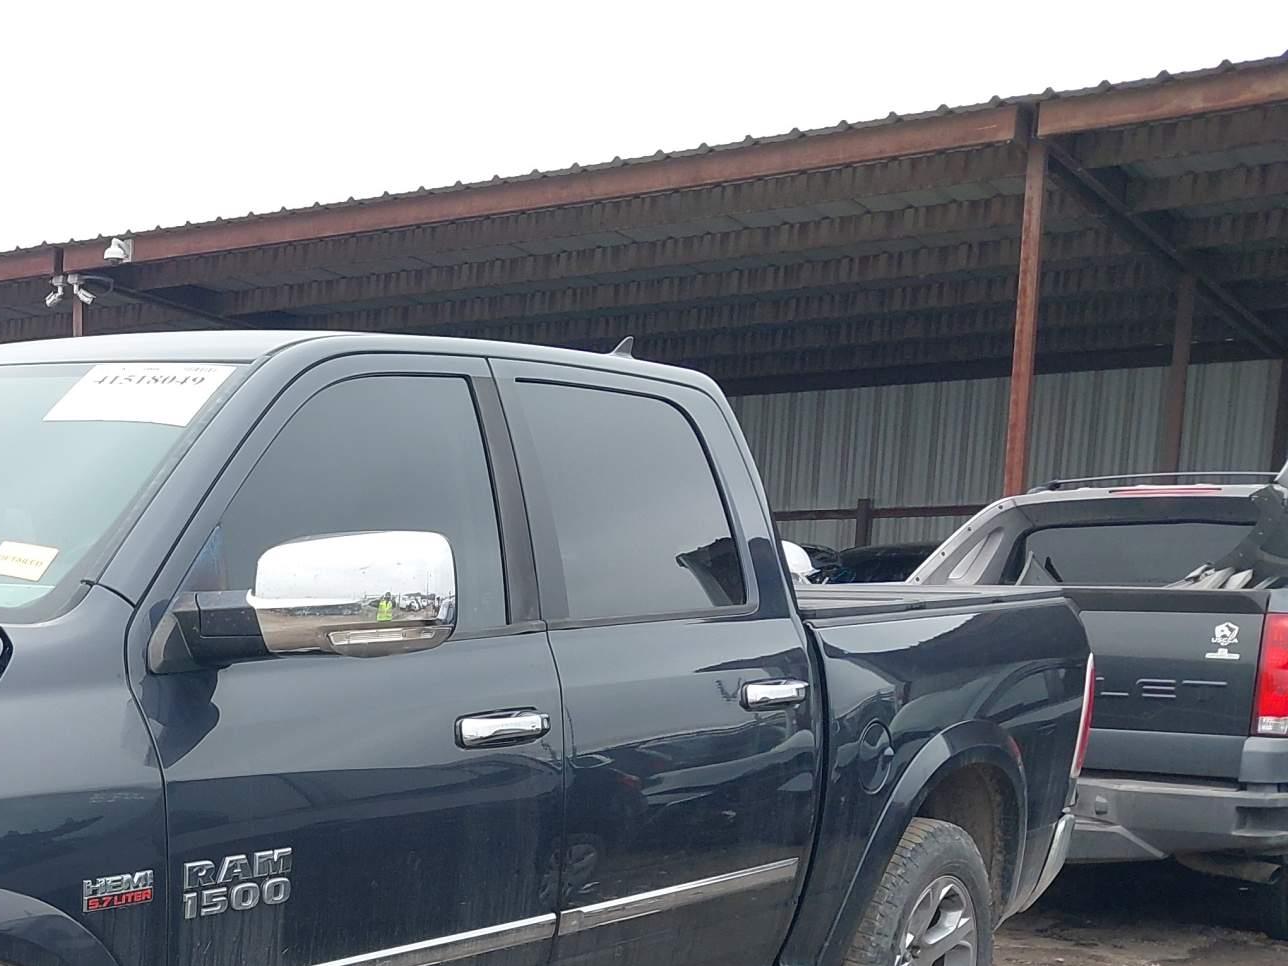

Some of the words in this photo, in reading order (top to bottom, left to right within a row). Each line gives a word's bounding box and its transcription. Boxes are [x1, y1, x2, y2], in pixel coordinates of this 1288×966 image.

[94, 374, 205, 386] 41518049
[183, 847, 293, 889] RAM
[82, 869, 154, 897] HEMI
[87, 896, 112, 911] 5.7
[113, 889, 153, 907] LITER
[183, 877, 292, 920] 1500
